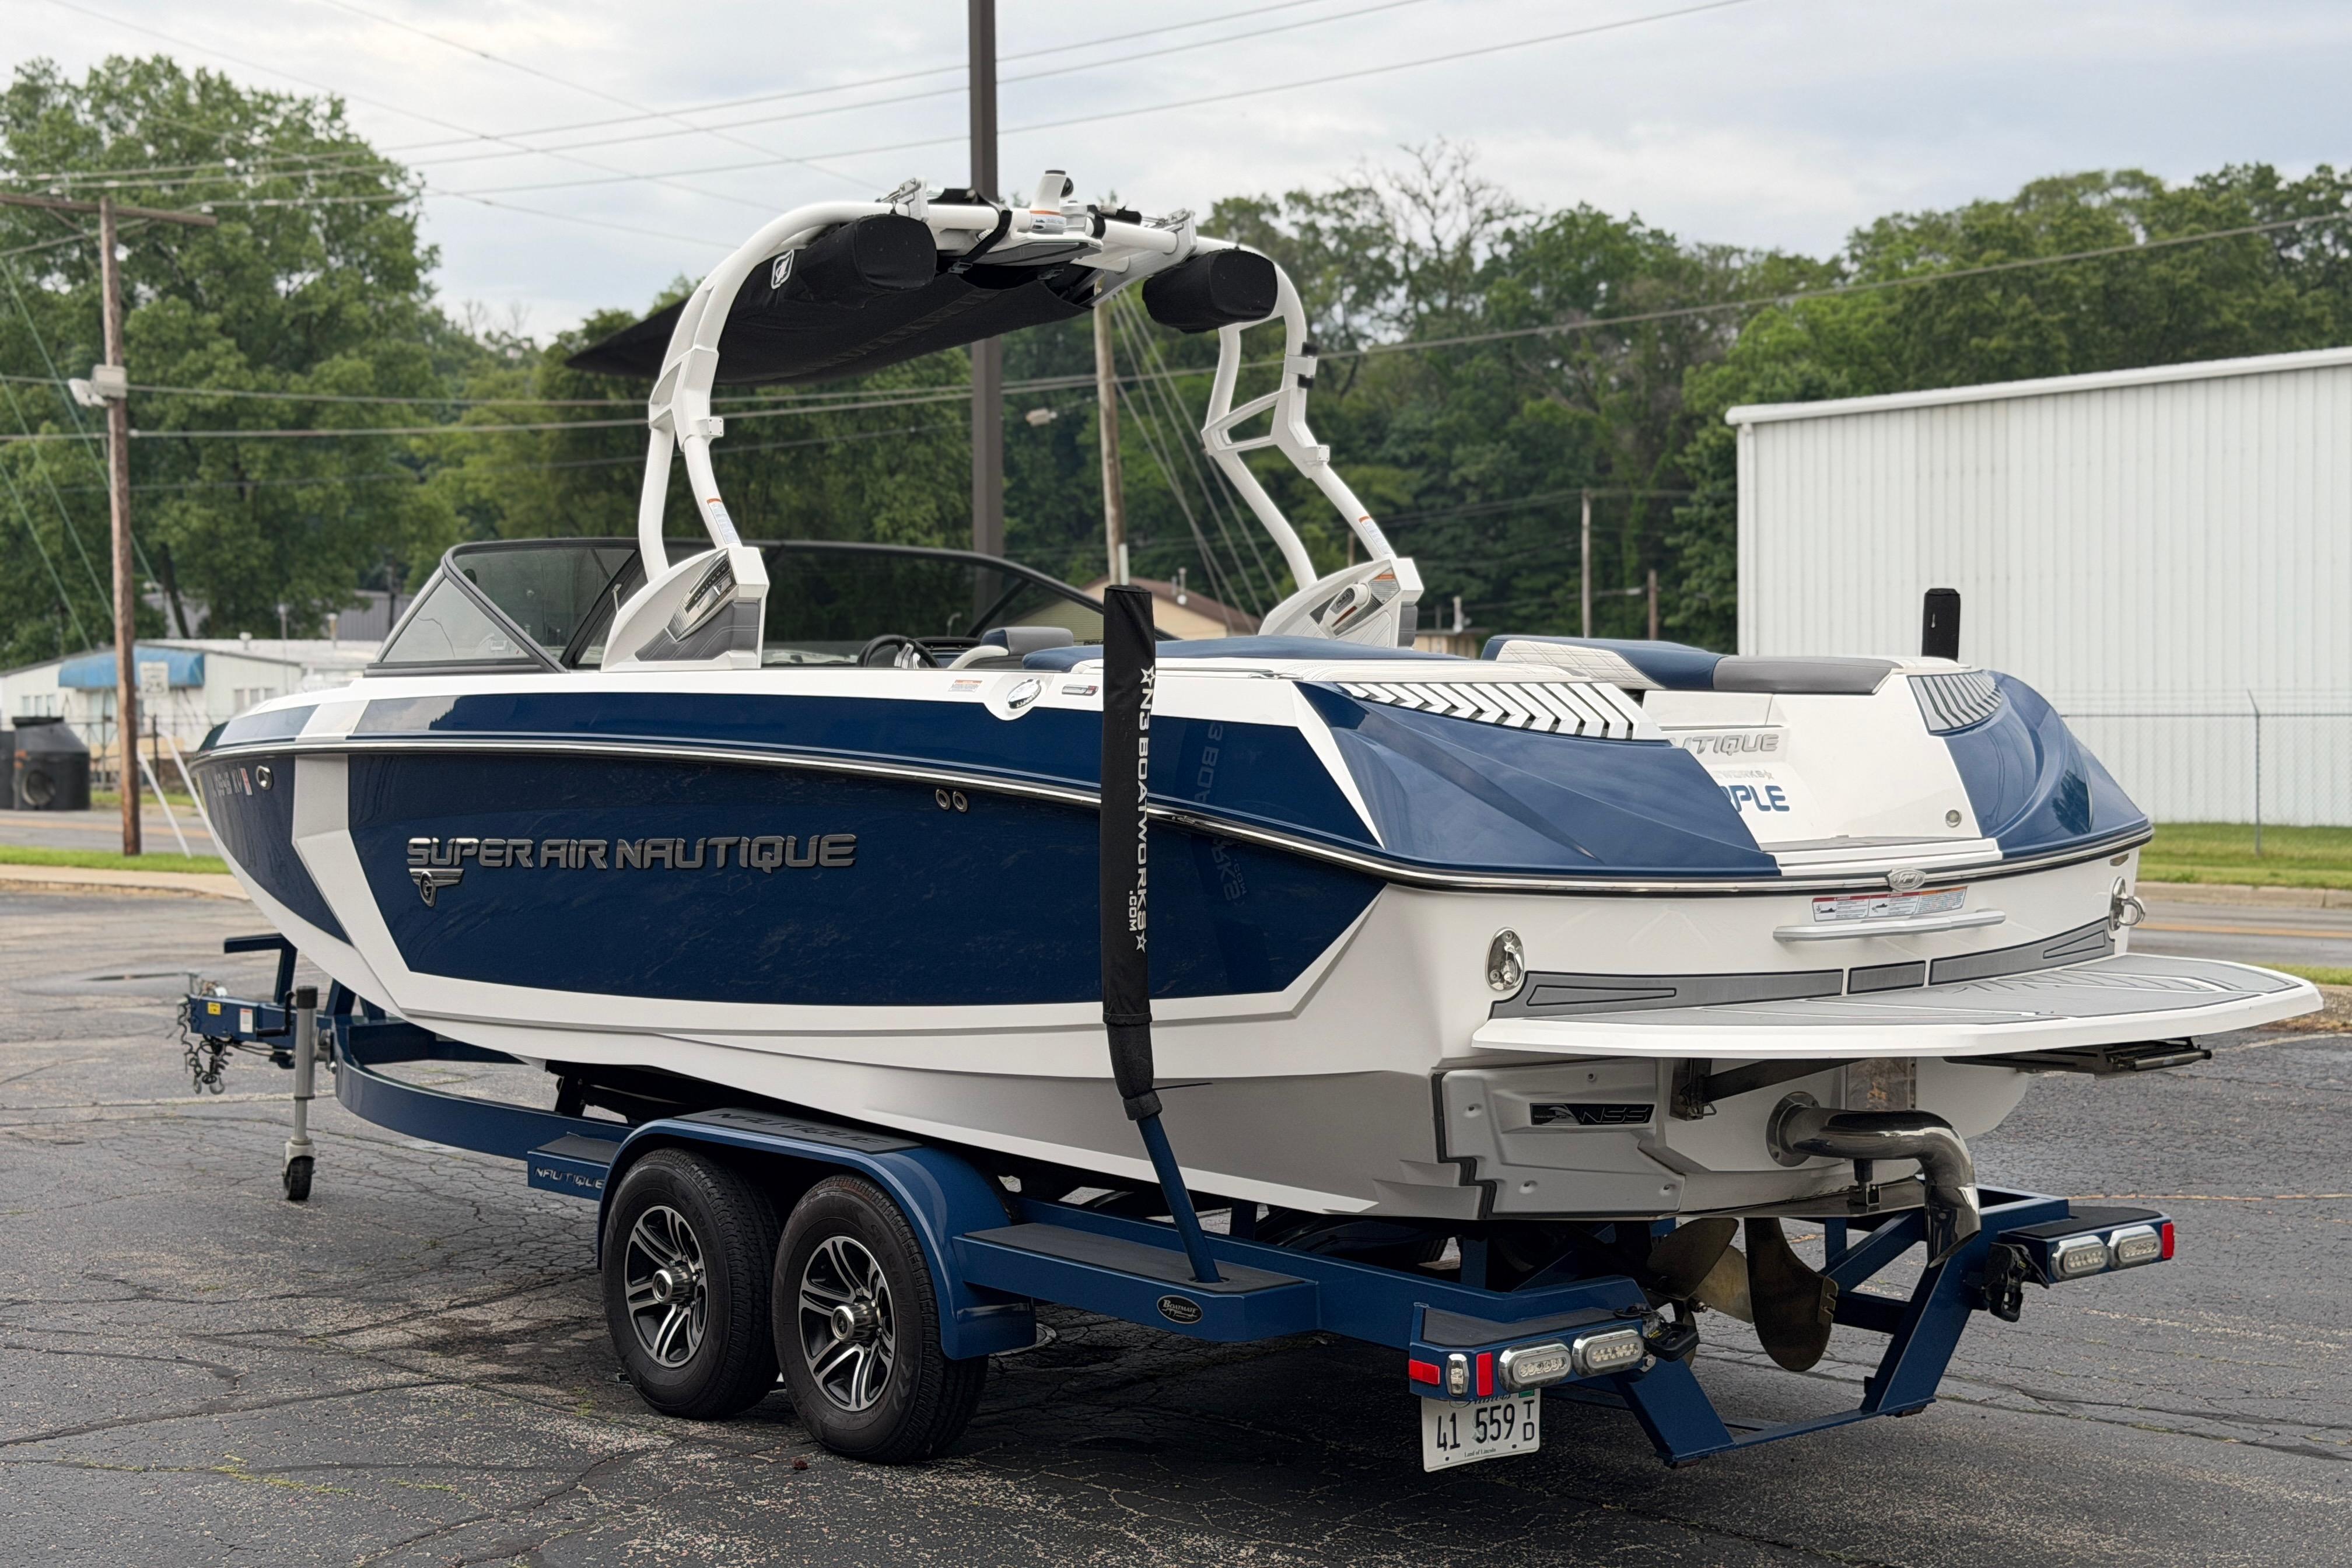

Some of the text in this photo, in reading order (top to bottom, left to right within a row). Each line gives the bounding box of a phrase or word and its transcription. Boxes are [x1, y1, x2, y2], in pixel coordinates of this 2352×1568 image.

[1138, 688, 1153, 930] N3 BOATWORKS
[407, 834, 858, 874] SUPER AIR NAUTIQUE
[1129, 890, 1137, 932] .COM
[709, 1113, 891, 1144] NAUTIQUE
[535, 1167, 605, 1189] NAUTIQUE
[1437, 1412, 1461, 1451] 41
[1475, 1403, 1516, 1444] 559
